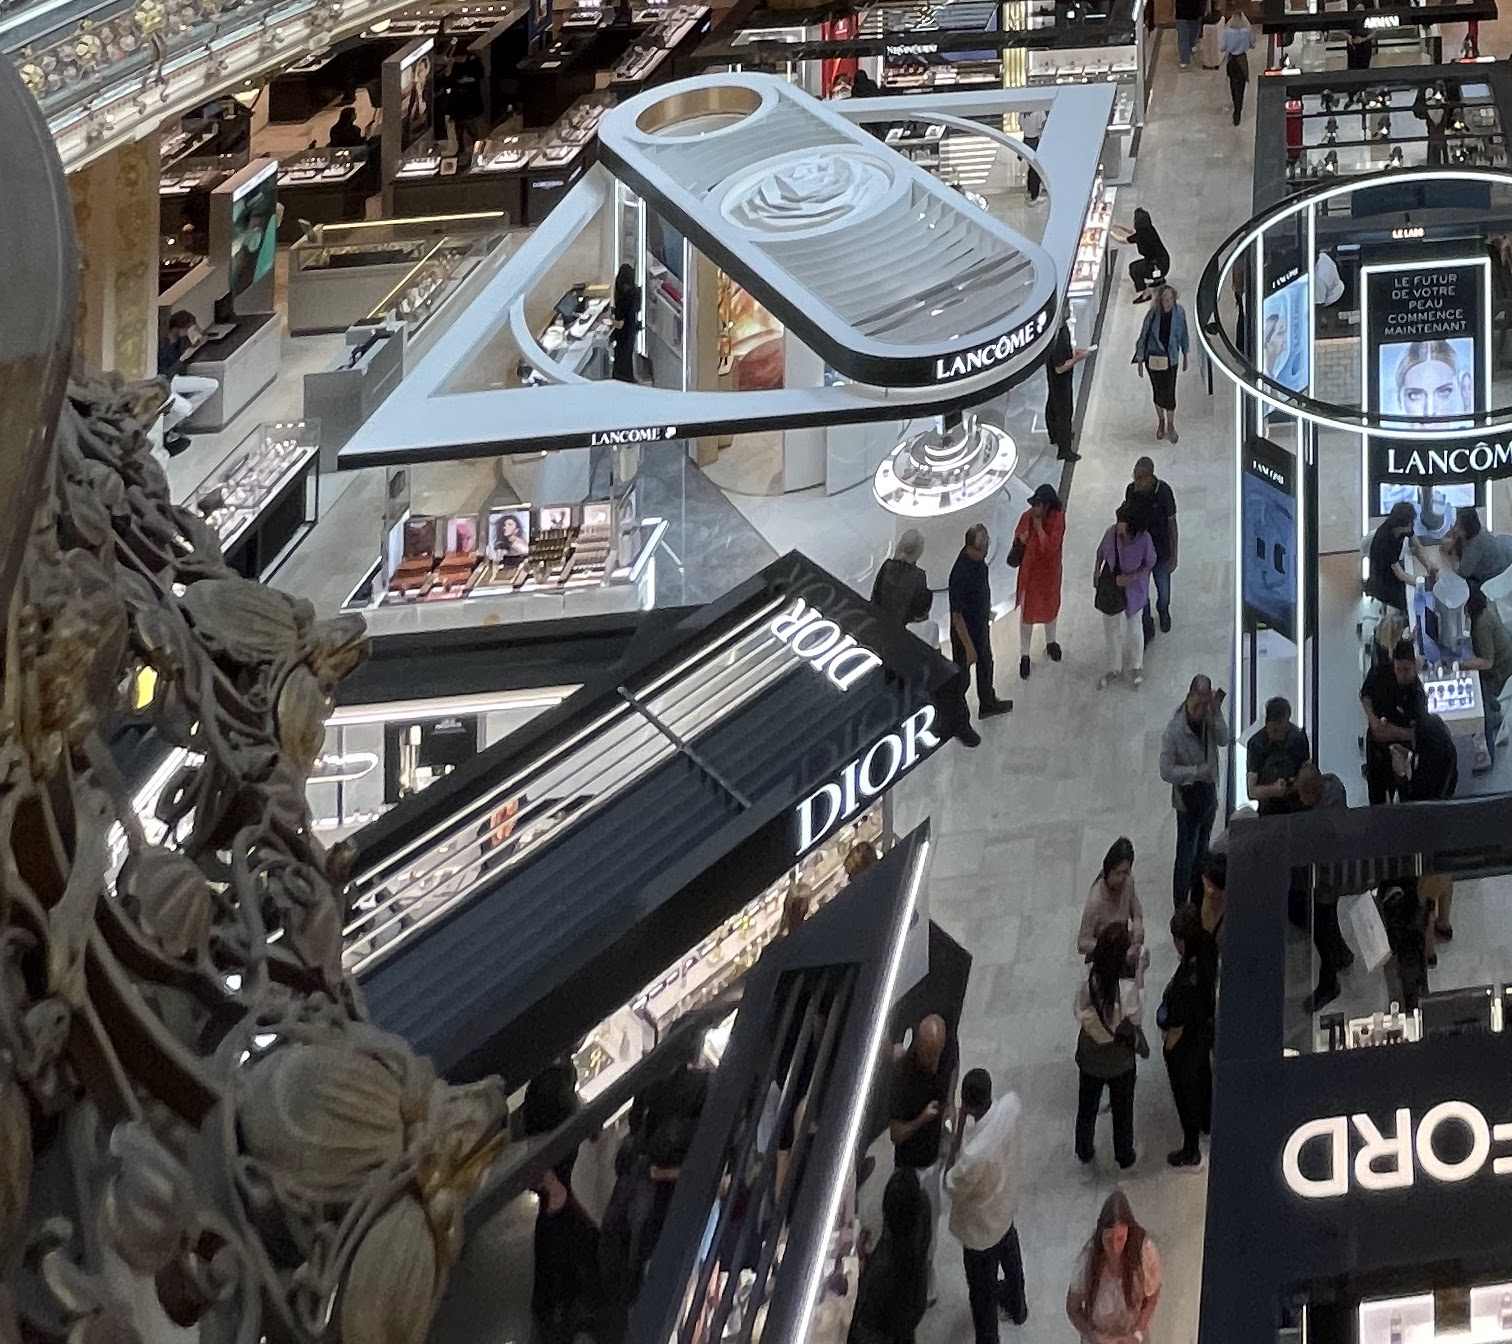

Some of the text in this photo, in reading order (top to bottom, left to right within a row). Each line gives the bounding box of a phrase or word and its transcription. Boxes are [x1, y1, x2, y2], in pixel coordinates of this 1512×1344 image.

[1394, 273, 1458, 288] LE FUTUR
[1391, 285, 1456, 300] DE VOTRE
[1408, 298, 1443, 309] PEAU
[1387, 308, 1464, 324] COMMENCE
[1384, 320, 1467, 336] MAINTENANT
[936, 323, 1036, 380] LANCÔME
[771, 597, 883, 692] DIOR
[795, 704, 940, 857] DIOR
